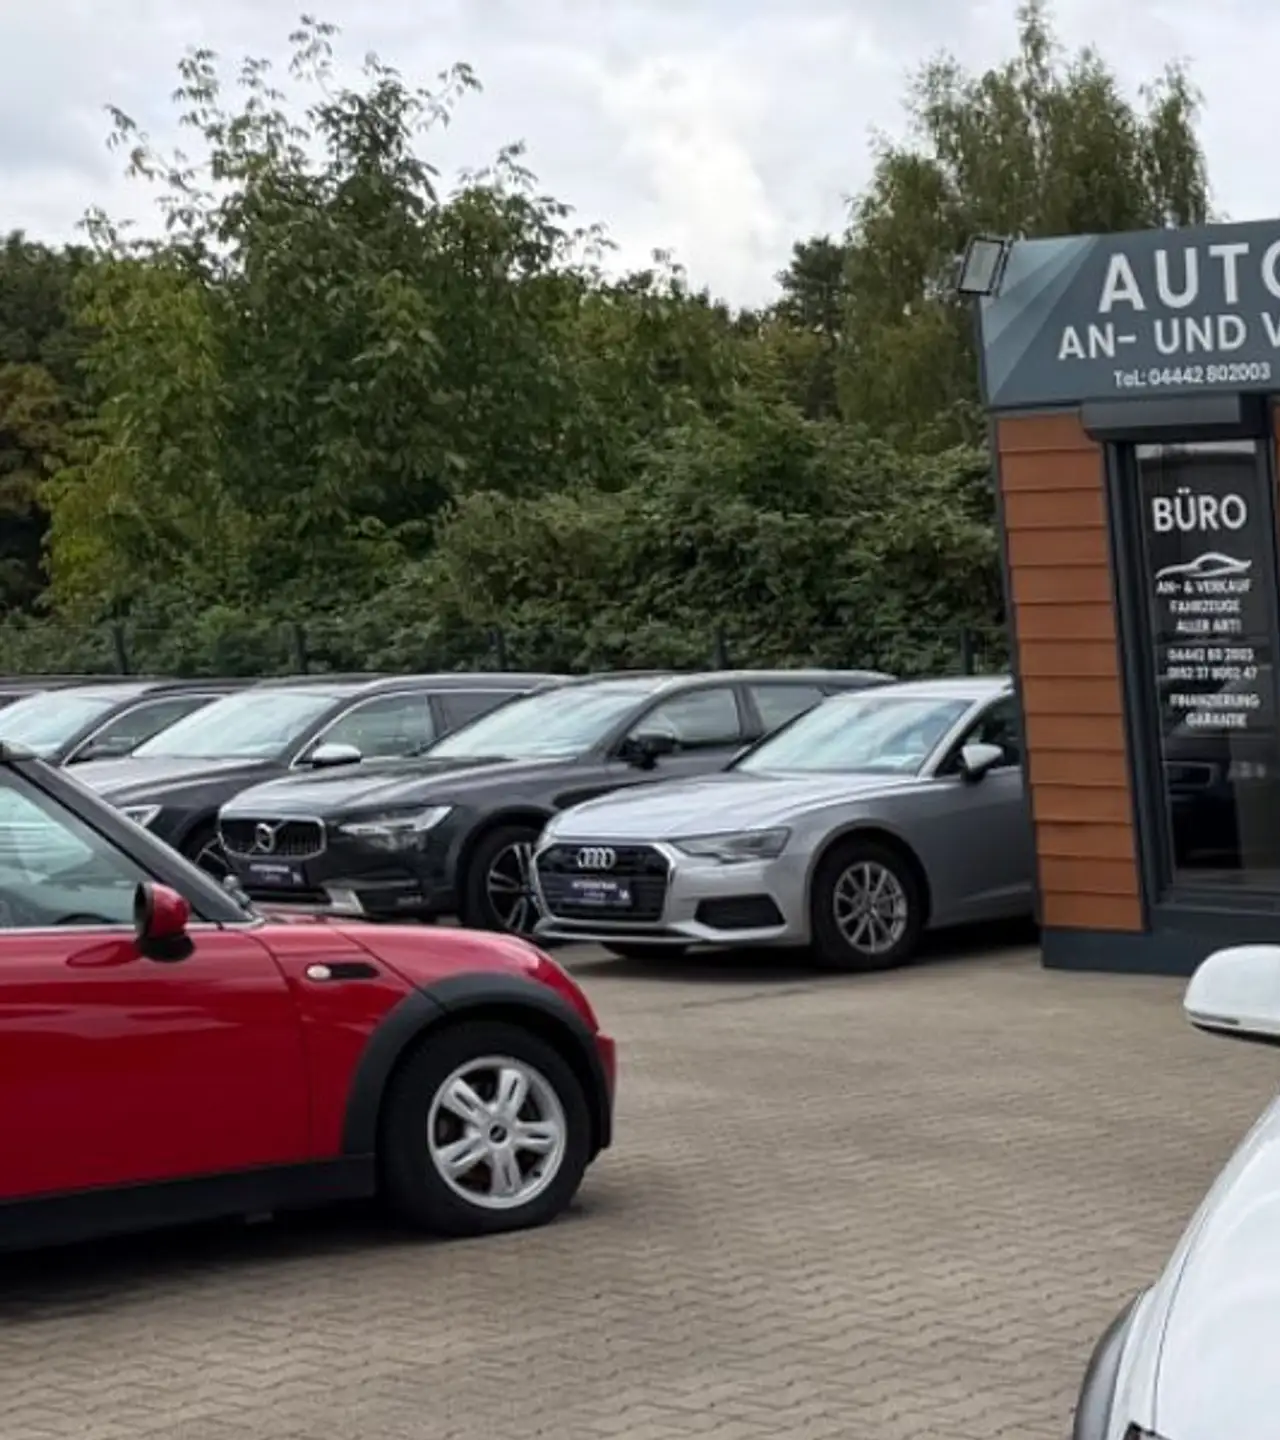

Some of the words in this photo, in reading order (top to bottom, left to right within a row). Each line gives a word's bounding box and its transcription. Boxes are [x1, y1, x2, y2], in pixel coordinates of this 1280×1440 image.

[1057, 323, 1137, 361] AN-
[1153, 313, 1248, 356] UND
[1148, 364, 1204, 386] 04442
[1205, 361, 1272, 383] 802003
[1150, 486, 1248, 533] BÜRO
